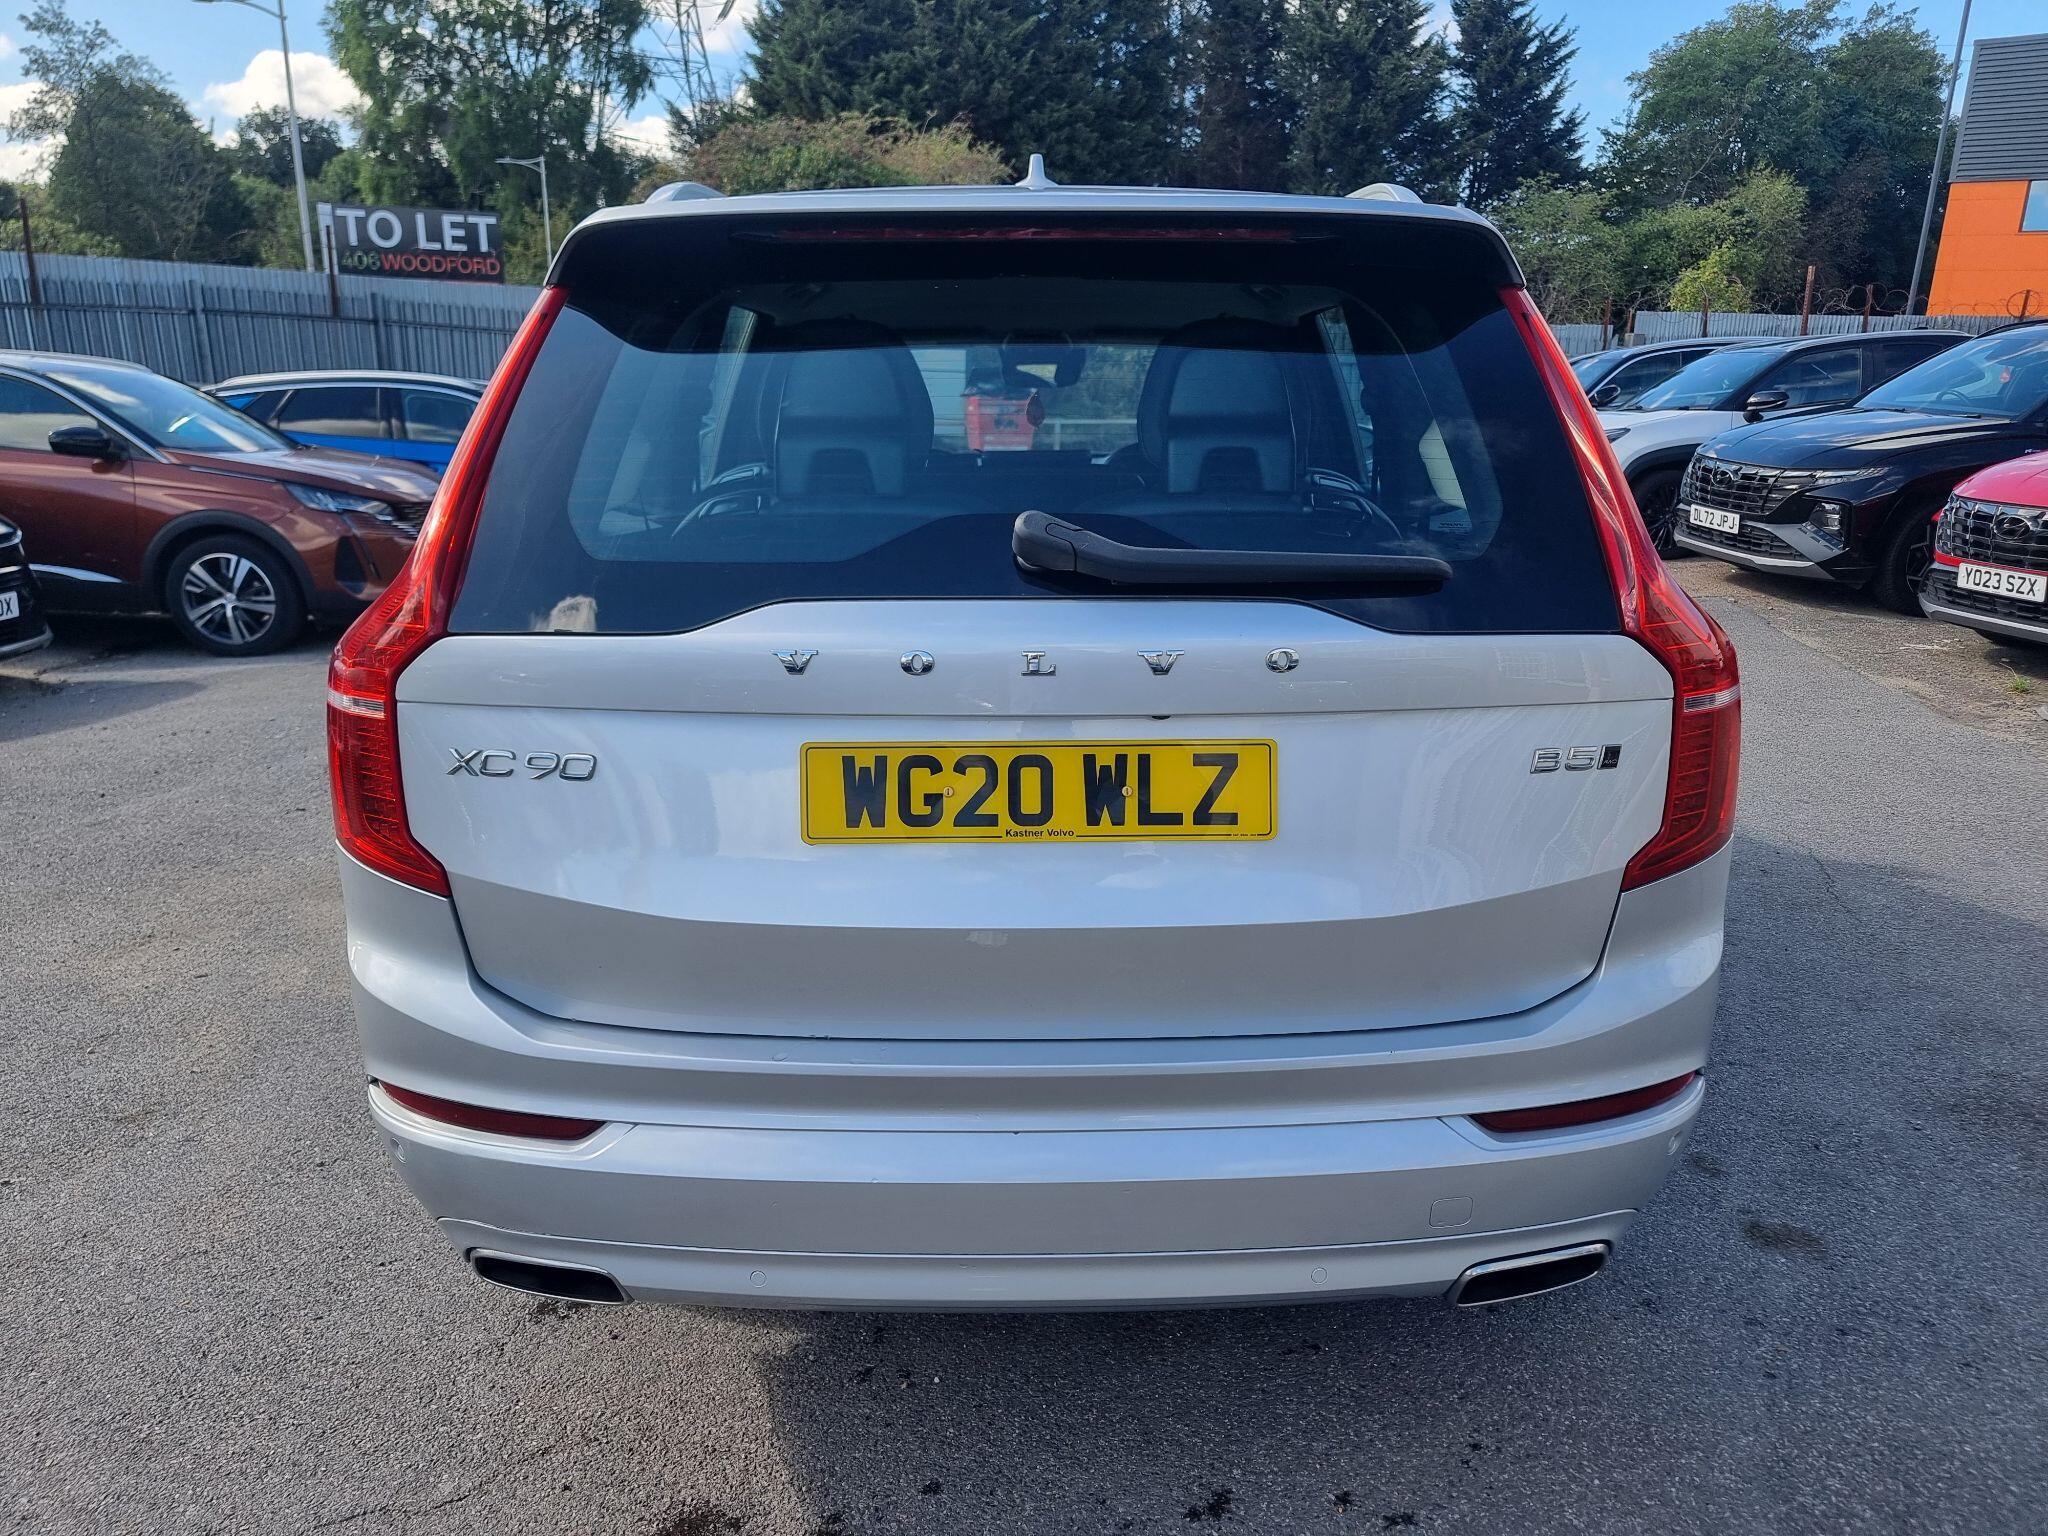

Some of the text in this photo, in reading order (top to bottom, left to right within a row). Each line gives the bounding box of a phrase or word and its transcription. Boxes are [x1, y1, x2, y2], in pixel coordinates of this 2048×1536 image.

[335, 207, 498, 253] TO LET
[1693, 508, 1736, 530] DL72 JPJ
[1965, 566, 2038, 597] YO23 SZX
[771, 647, 1300, 676] VOLVO
[446, 748, 598, 782] XC90
[1530, 746, 1598, 774] B5
[841, 753, 1239, 829] WG20 WLZ
[1005, 828, 1075, 838] Kastner Volvo
